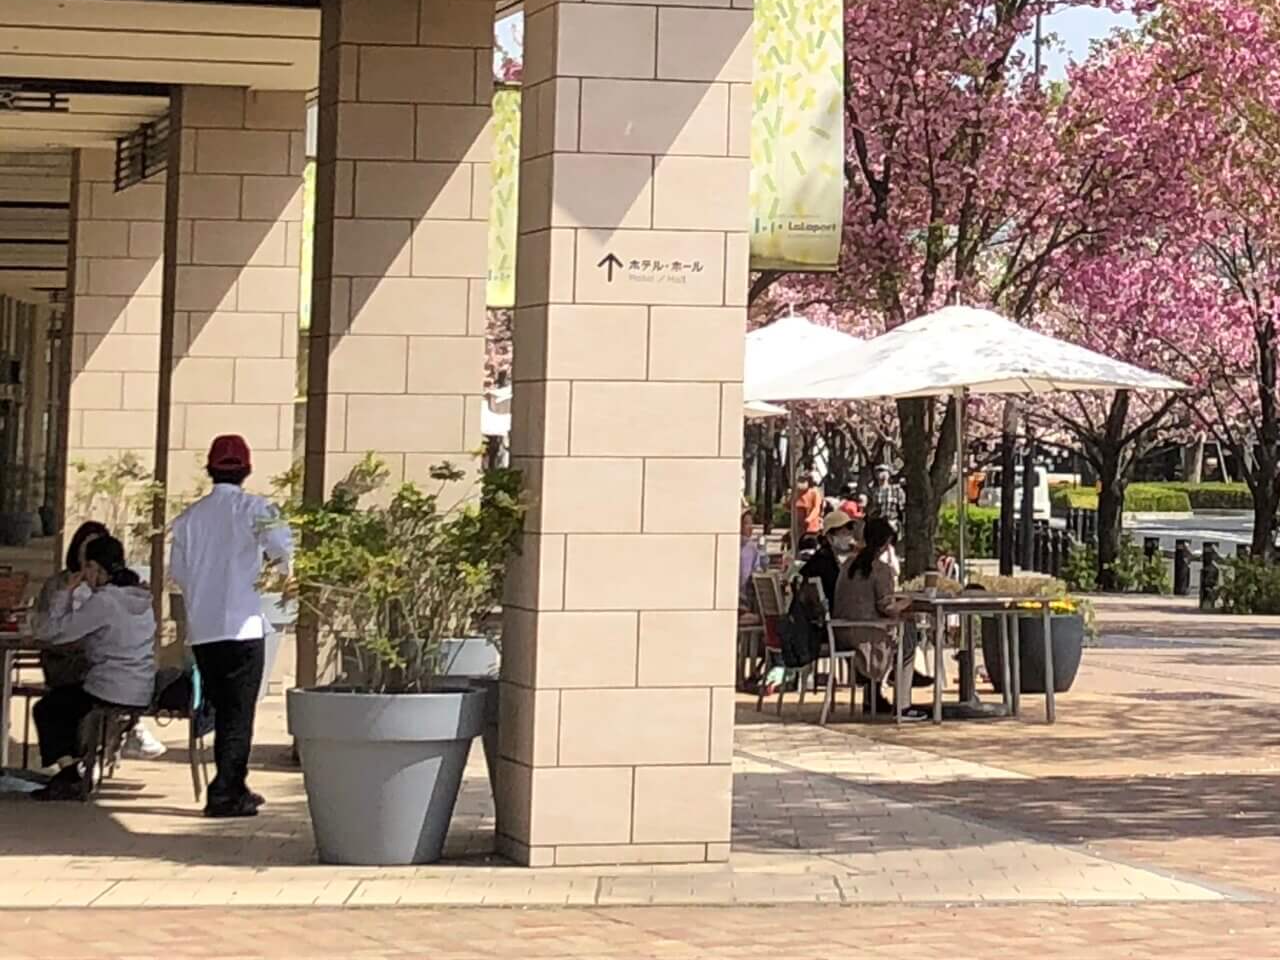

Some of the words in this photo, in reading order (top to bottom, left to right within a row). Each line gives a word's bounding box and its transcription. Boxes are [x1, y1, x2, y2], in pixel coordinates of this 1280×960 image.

[628, 259, 704, 273] ホテル・ホール
